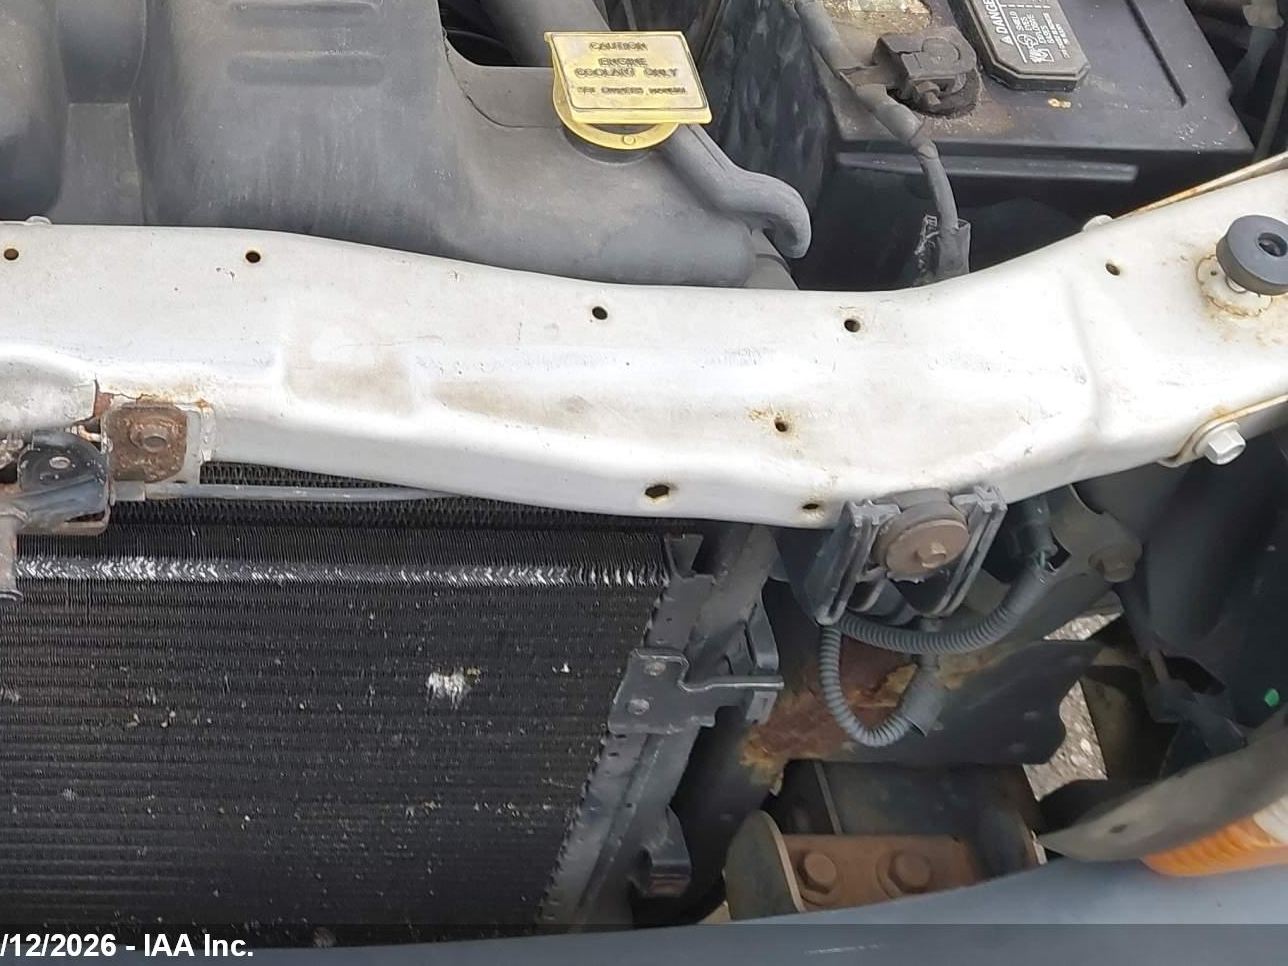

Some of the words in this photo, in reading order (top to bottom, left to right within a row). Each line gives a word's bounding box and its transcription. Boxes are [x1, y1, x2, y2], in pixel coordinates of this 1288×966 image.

[588, 41, 649, 52] CAUTION
[598, 57, 649, 67] ENGINE
[643, 67, 679, 78] ONLY
